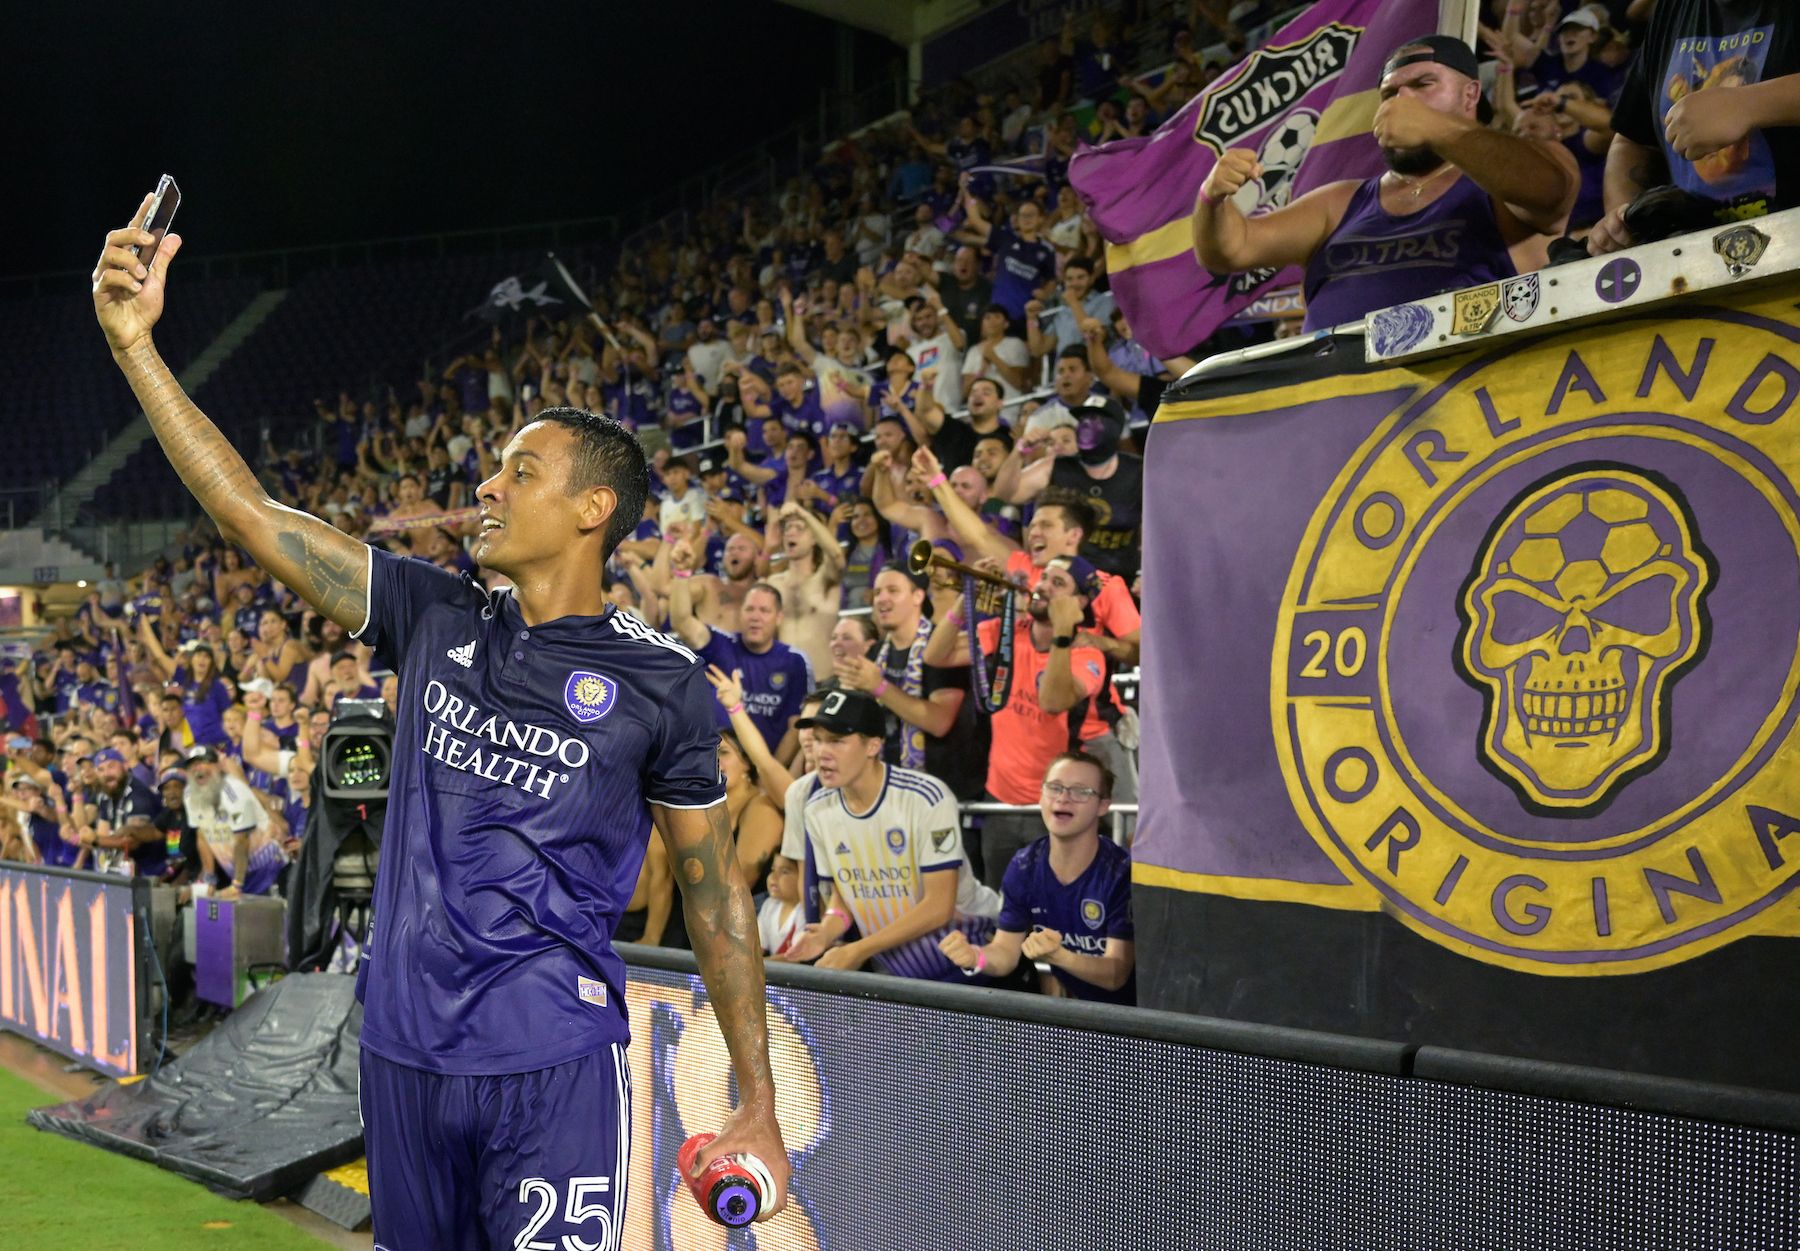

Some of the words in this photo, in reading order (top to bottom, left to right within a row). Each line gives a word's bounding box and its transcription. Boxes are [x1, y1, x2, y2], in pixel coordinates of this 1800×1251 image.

[1718, 31, 1764, 52] RUDD
[1458, 289, 1495, 302] ORLANDO
[1353, 334, 1800, 549] ORLAND
[447, 648, 474, 669] adidas
[1300, 627, 1368, 678] 20
[570, 703, 600, 716] ORLANDO
[578, 709, 591, 717] CITY
[424, 680, 590, 768] ORLANDO
[1324, 746, 1800, 937] ORIGINA
[837, 865, 911, 884] ORLANDO
[850, 882, 909, 898] HEALTH
[514, 1176, 613, 1251] 25
